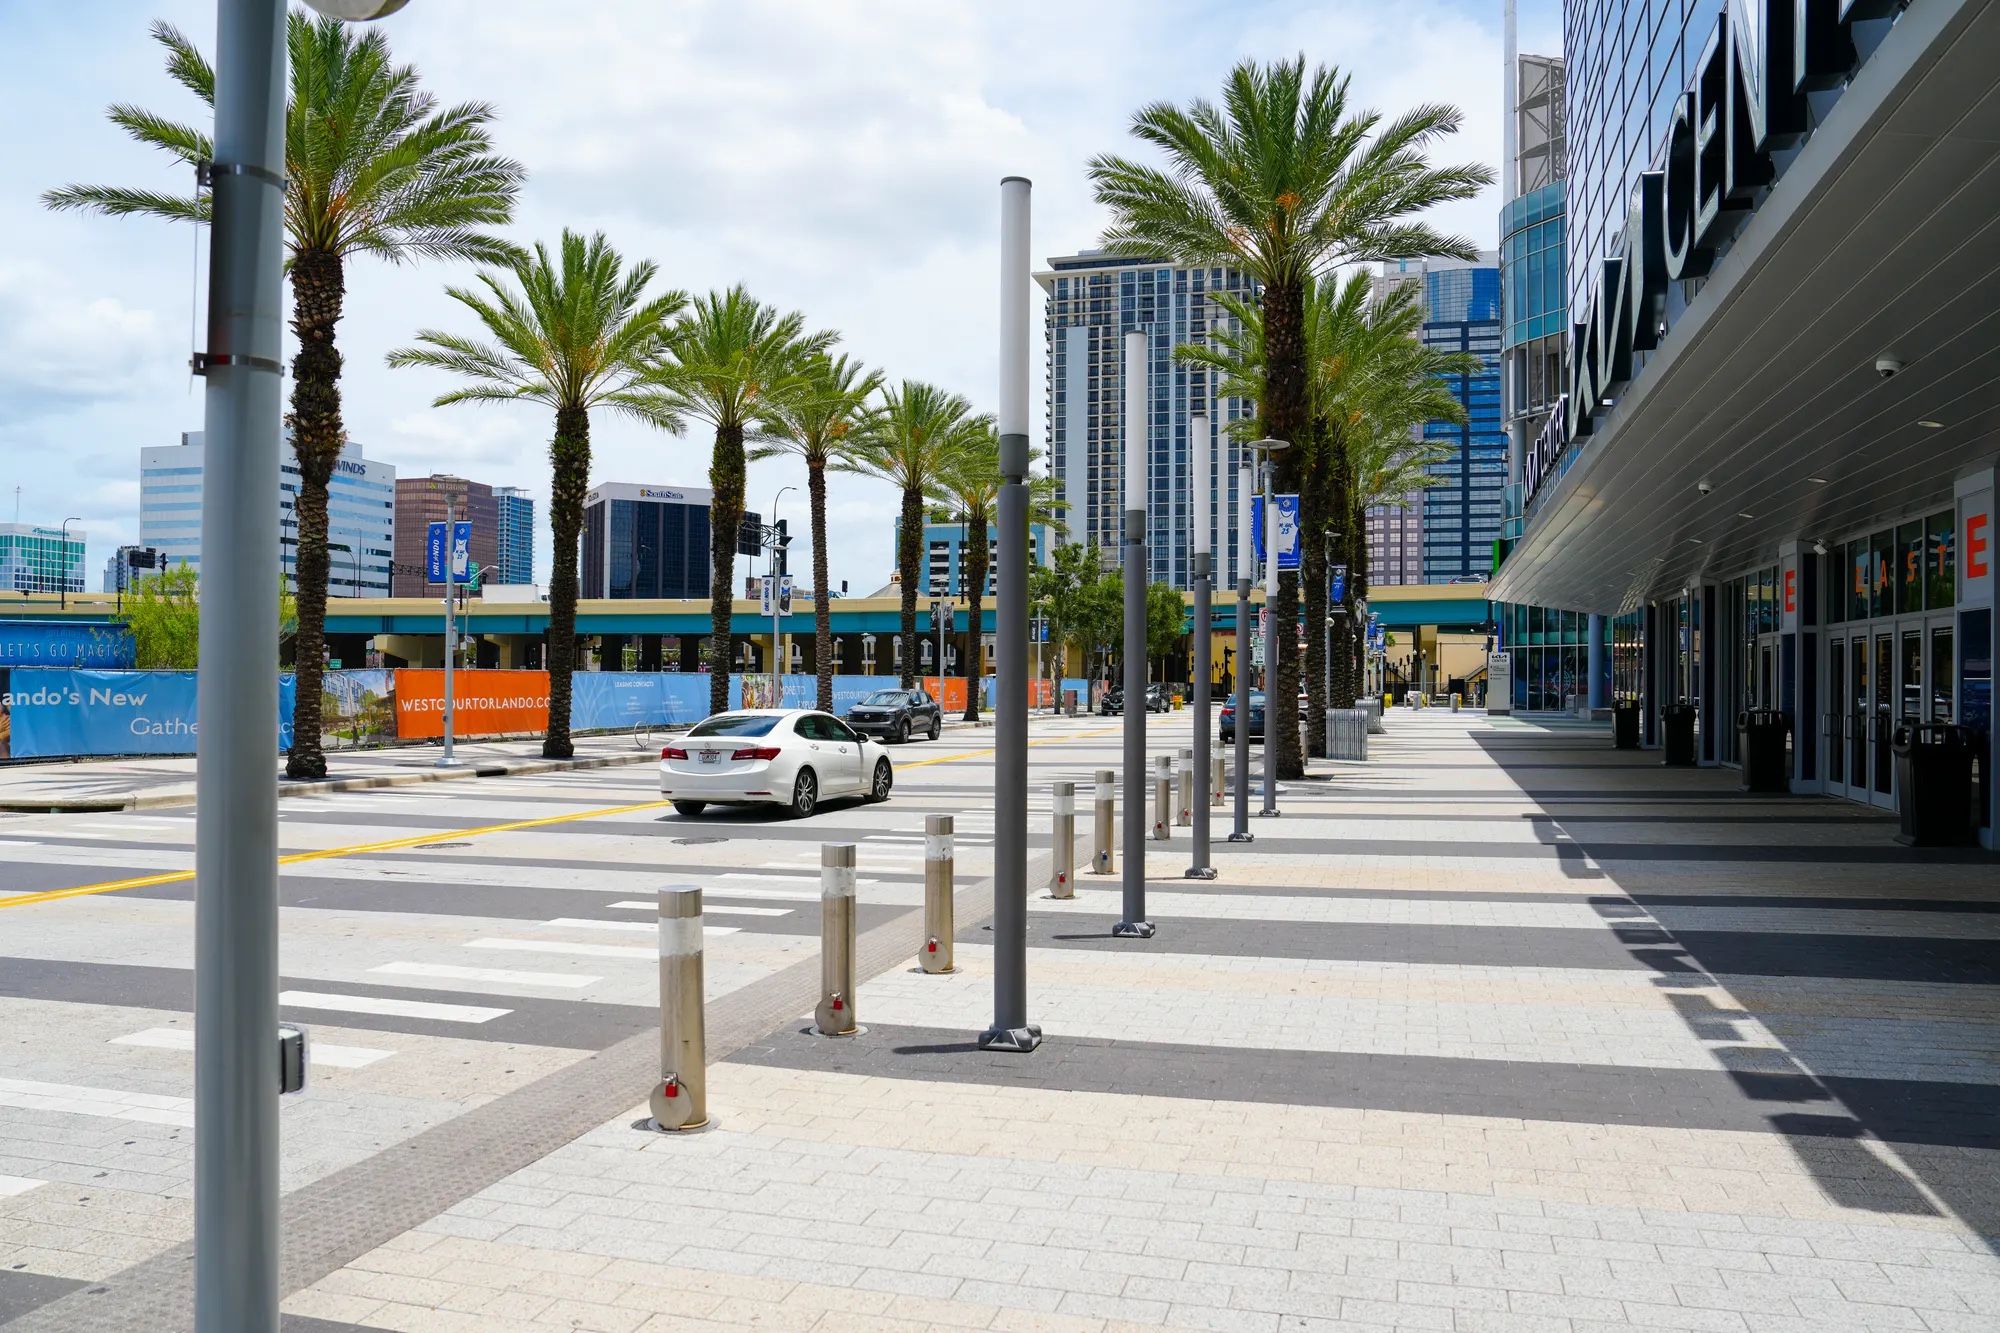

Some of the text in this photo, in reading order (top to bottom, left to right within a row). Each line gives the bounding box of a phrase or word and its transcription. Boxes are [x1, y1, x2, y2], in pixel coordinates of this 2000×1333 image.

[1966, 513, 1988, 580] E
[1784, 569, 1796, 613] E
[0, 643, 119, 658] LET'S GO MAGIC
[2, 686, 148, 706] ando's New
